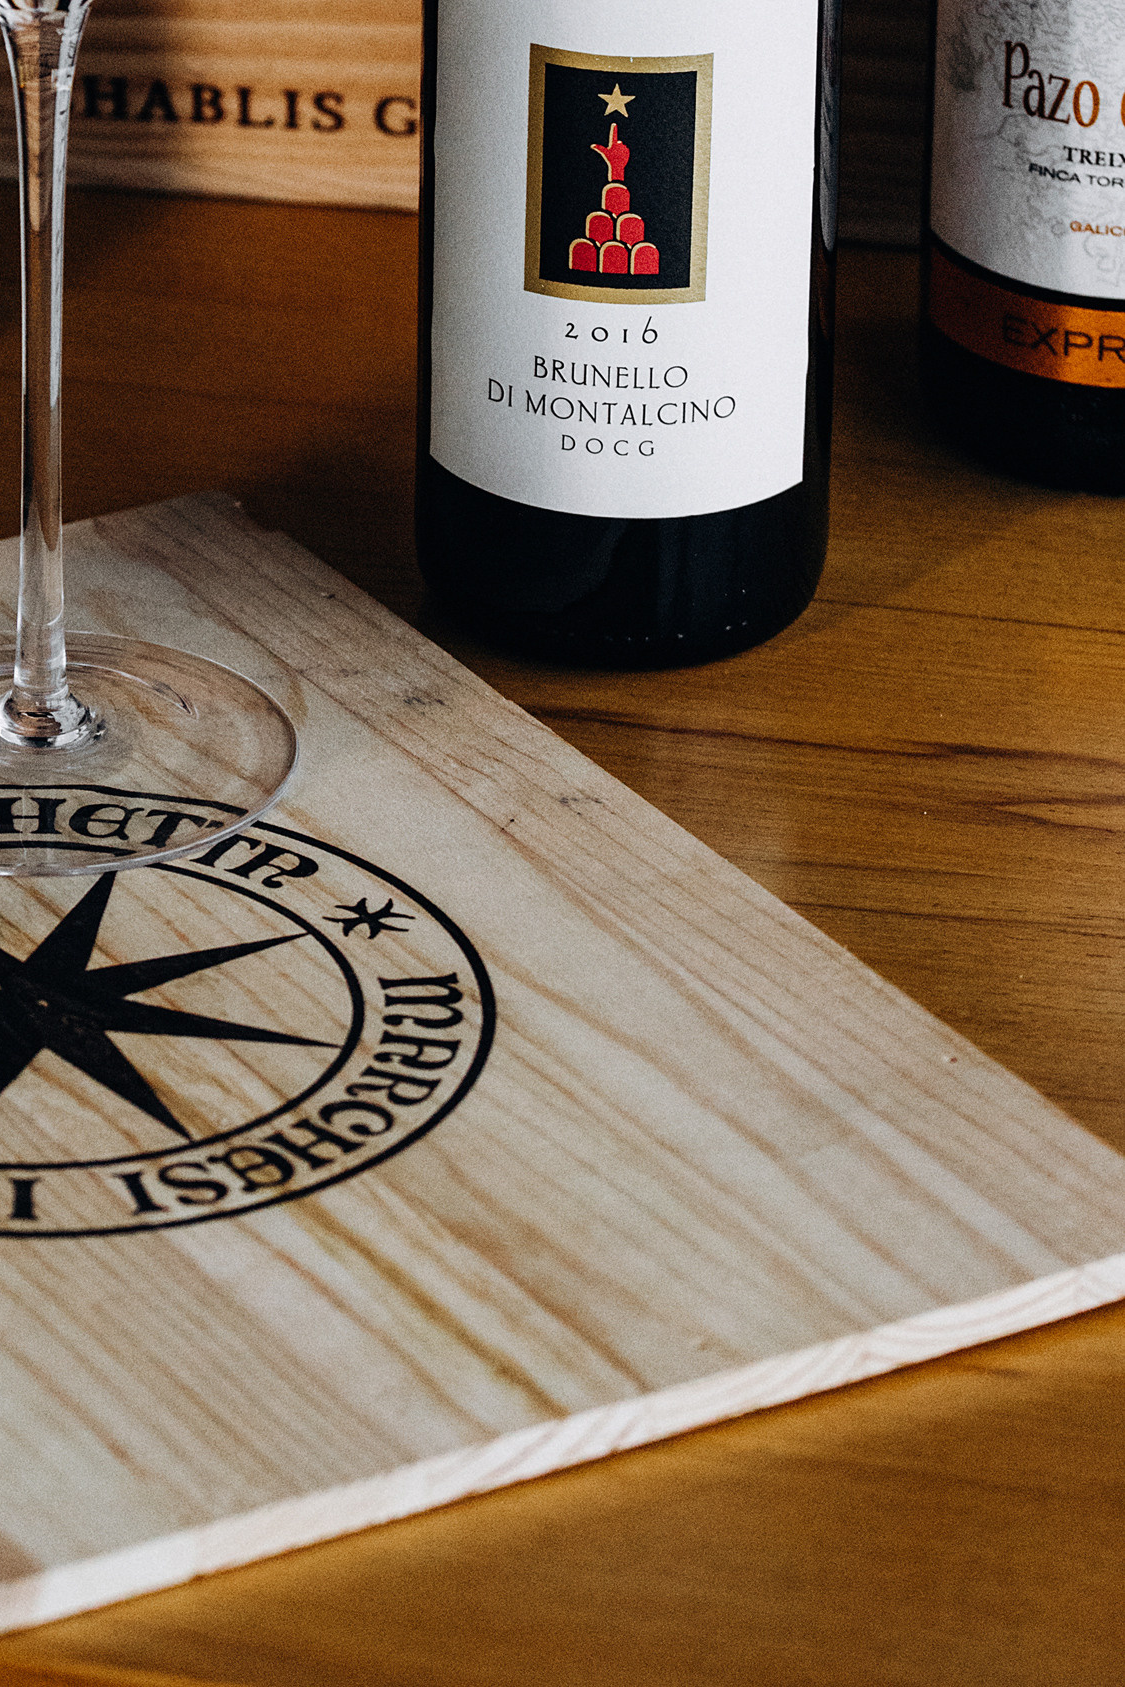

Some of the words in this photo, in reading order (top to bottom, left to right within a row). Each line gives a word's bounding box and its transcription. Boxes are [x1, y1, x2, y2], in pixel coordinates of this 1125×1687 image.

[1001, 39, 1102, 129] Pazo
[81, 73, 348, 136] HABLIS
[1028, 162, 1081, 185] FINCA
[564, 315, 659, 344] 2016
[532, 354, 689, 389] BRUNELLO
[487, 377, 514, 408] DI
[525, 389, 737, 427] MONTALCINO
[560, 434, 655, 457] DOCG
